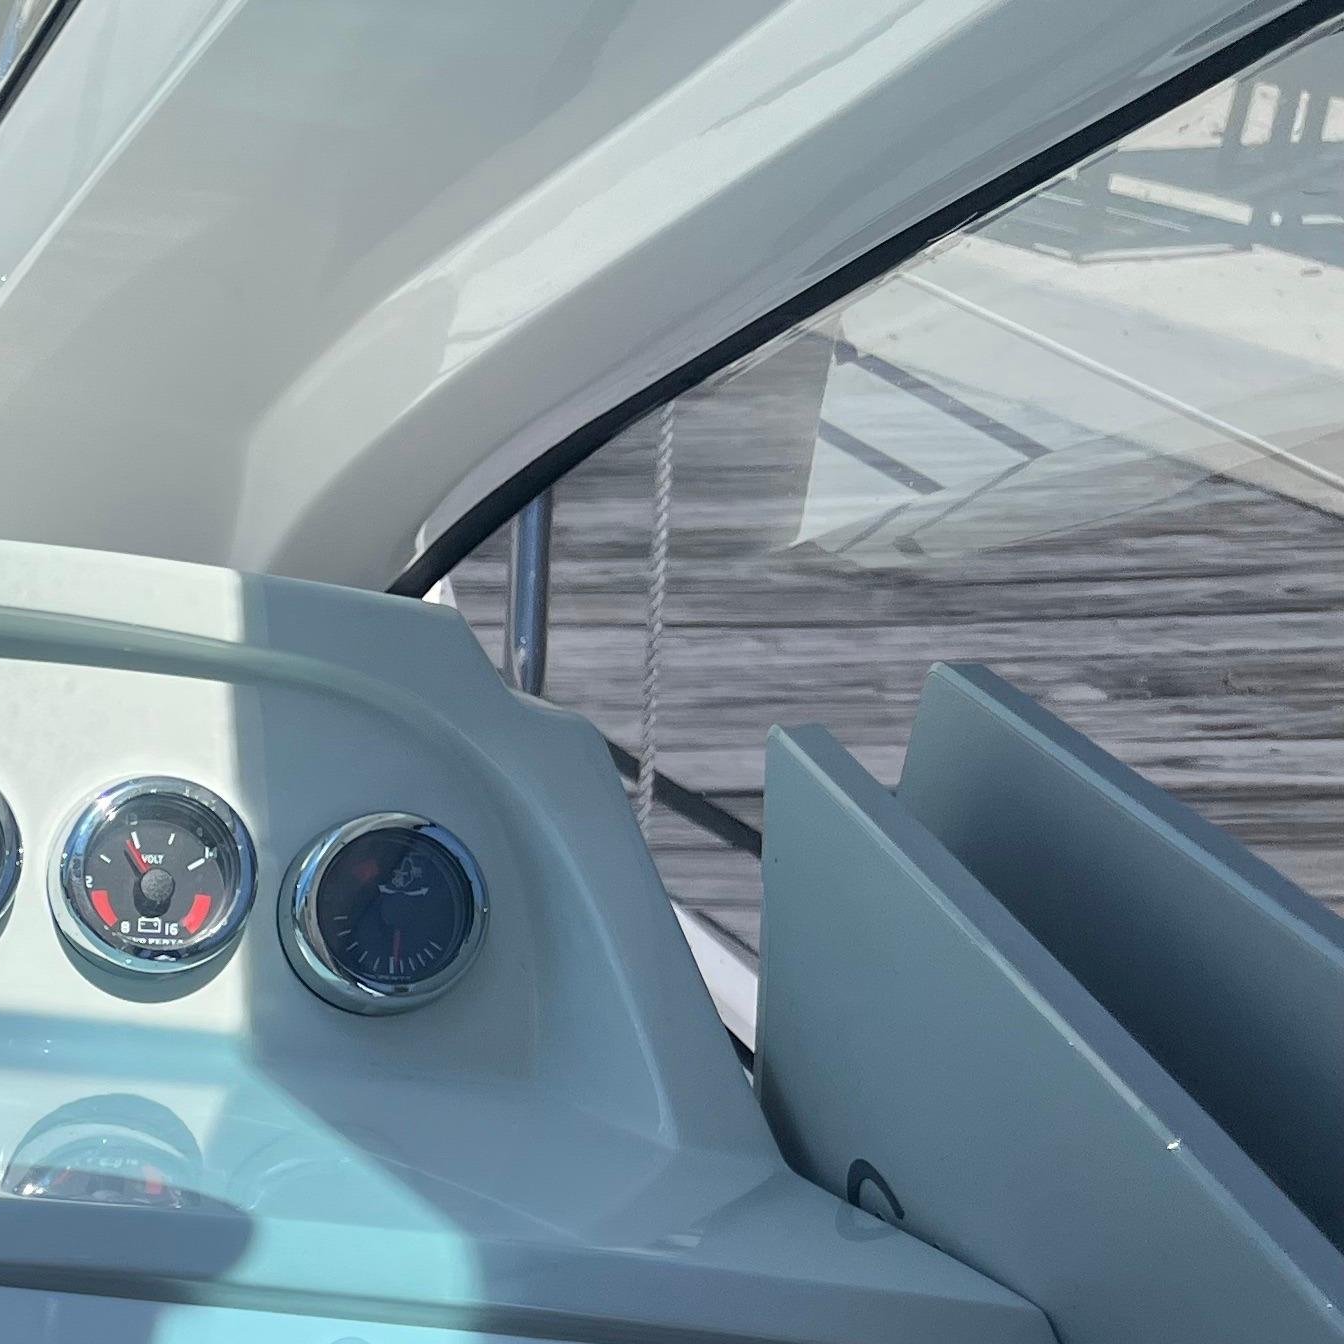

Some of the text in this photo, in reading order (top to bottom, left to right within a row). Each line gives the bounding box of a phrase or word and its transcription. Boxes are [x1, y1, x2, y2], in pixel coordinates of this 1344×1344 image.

[141, 854, 164, 864] VOLT
[121, 921, 130, 933] 8
[165, 924, 178, 936] 16
